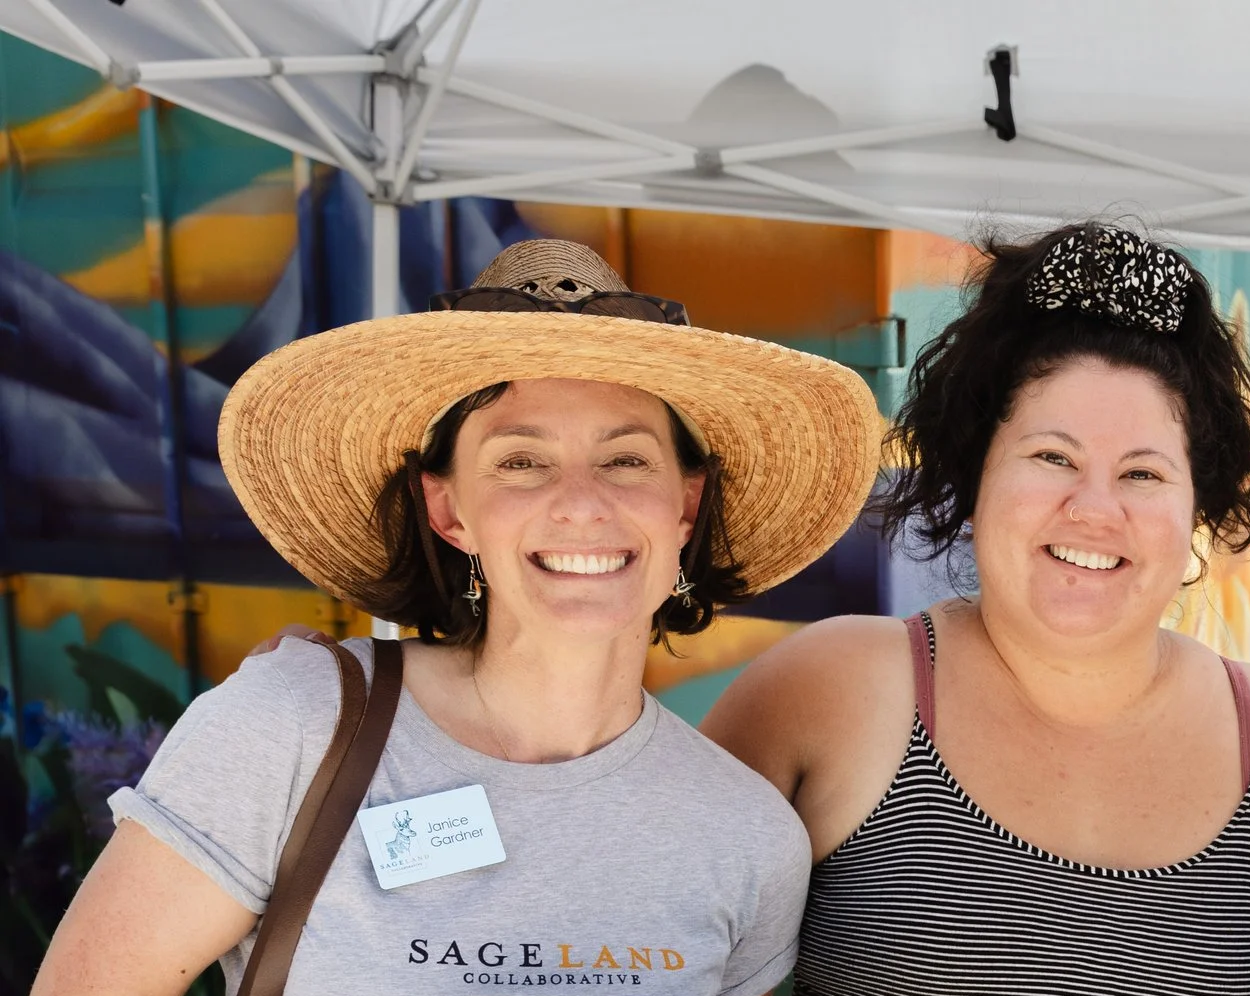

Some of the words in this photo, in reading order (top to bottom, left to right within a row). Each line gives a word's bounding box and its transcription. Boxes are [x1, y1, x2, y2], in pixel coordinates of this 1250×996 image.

[427, 816, 469, 834] Janice
[430, 827, 484, 847] Gardner
[463, 972, 641, 986] COLLABORATIVE
